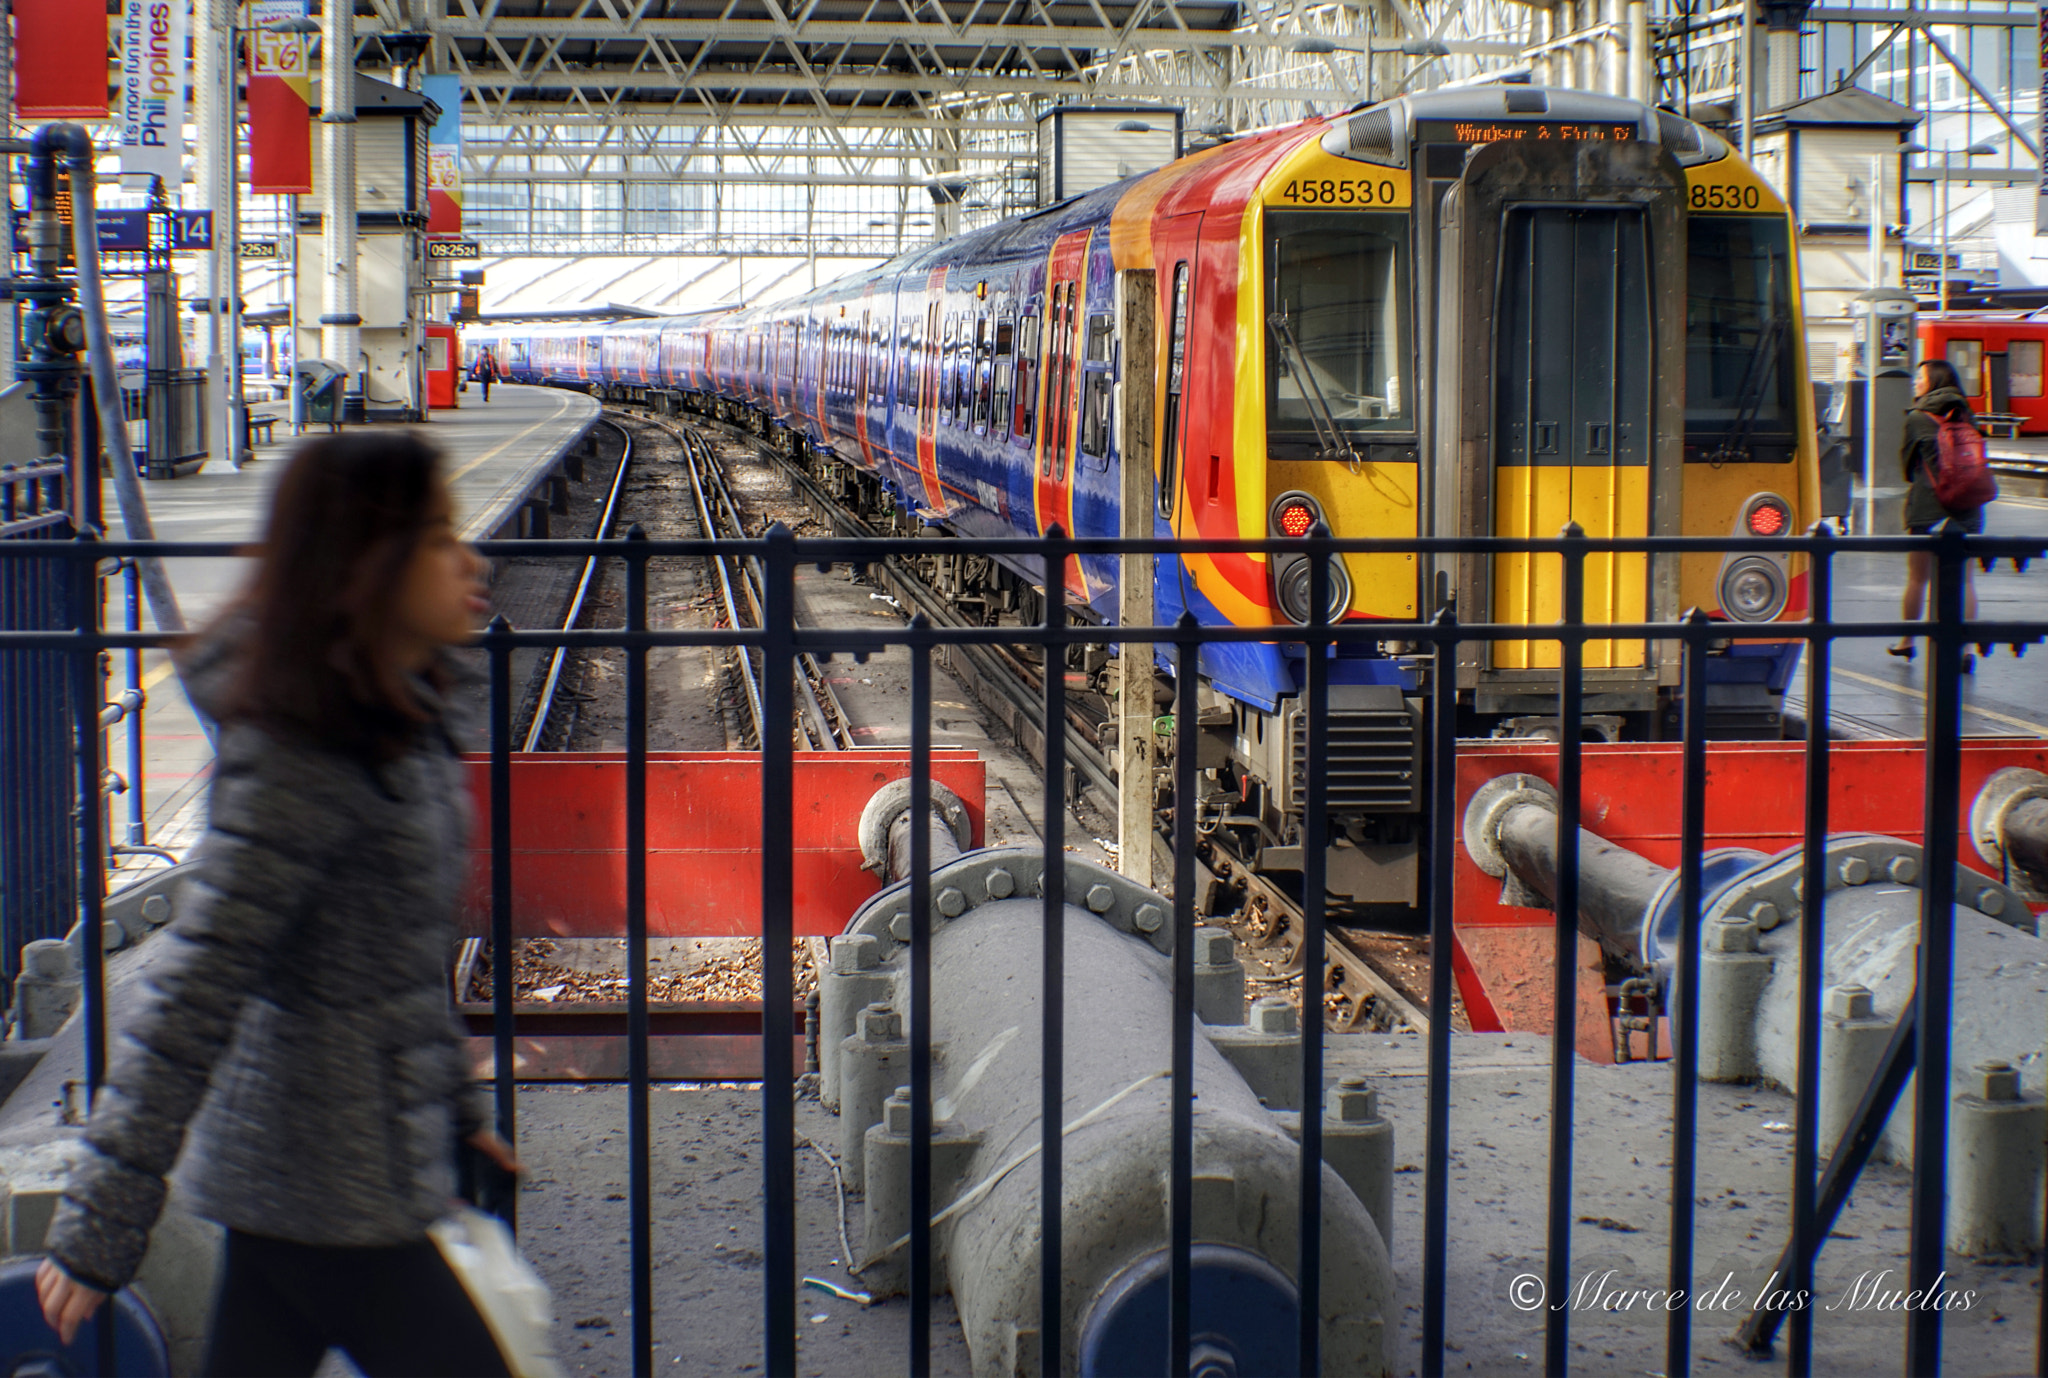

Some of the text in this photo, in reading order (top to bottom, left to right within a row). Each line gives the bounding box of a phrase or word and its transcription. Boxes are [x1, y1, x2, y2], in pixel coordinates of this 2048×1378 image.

[123, 2, 141, 146] It's more fun in the
[141, 3, 175, 147] Philippines
[1283, 180, 1395, 204] 458530
[1687, 184, 1760, 209] 8530
[177, 216, 210, 242] 14
